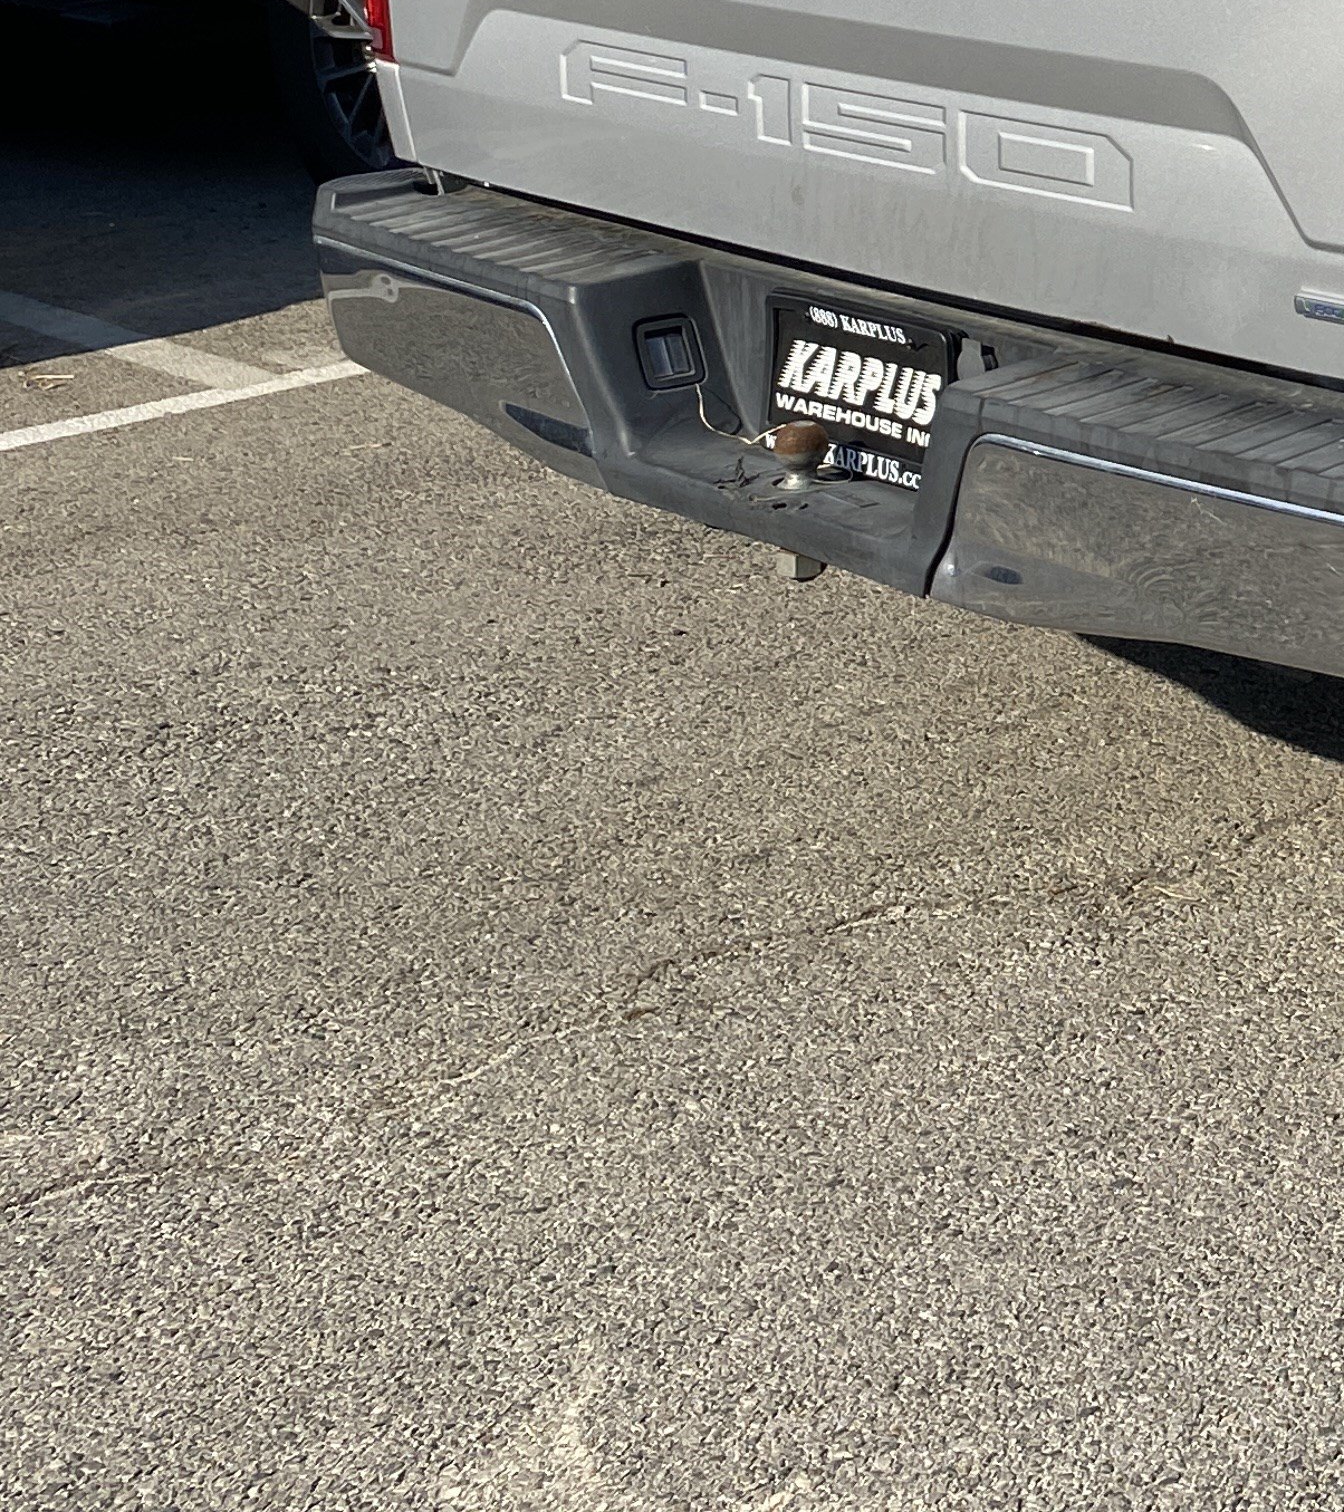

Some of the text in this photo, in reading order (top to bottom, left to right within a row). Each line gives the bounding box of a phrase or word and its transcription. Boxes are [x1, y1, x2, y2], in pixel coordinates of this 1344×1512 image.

[559, 39, 1133, 212] F-150
[809, 306, 906, 345] (888) KARPLUS
[775, 392, 904, 439] WAREHOUSE
[777, 339, 942, 426] KARPLUS
